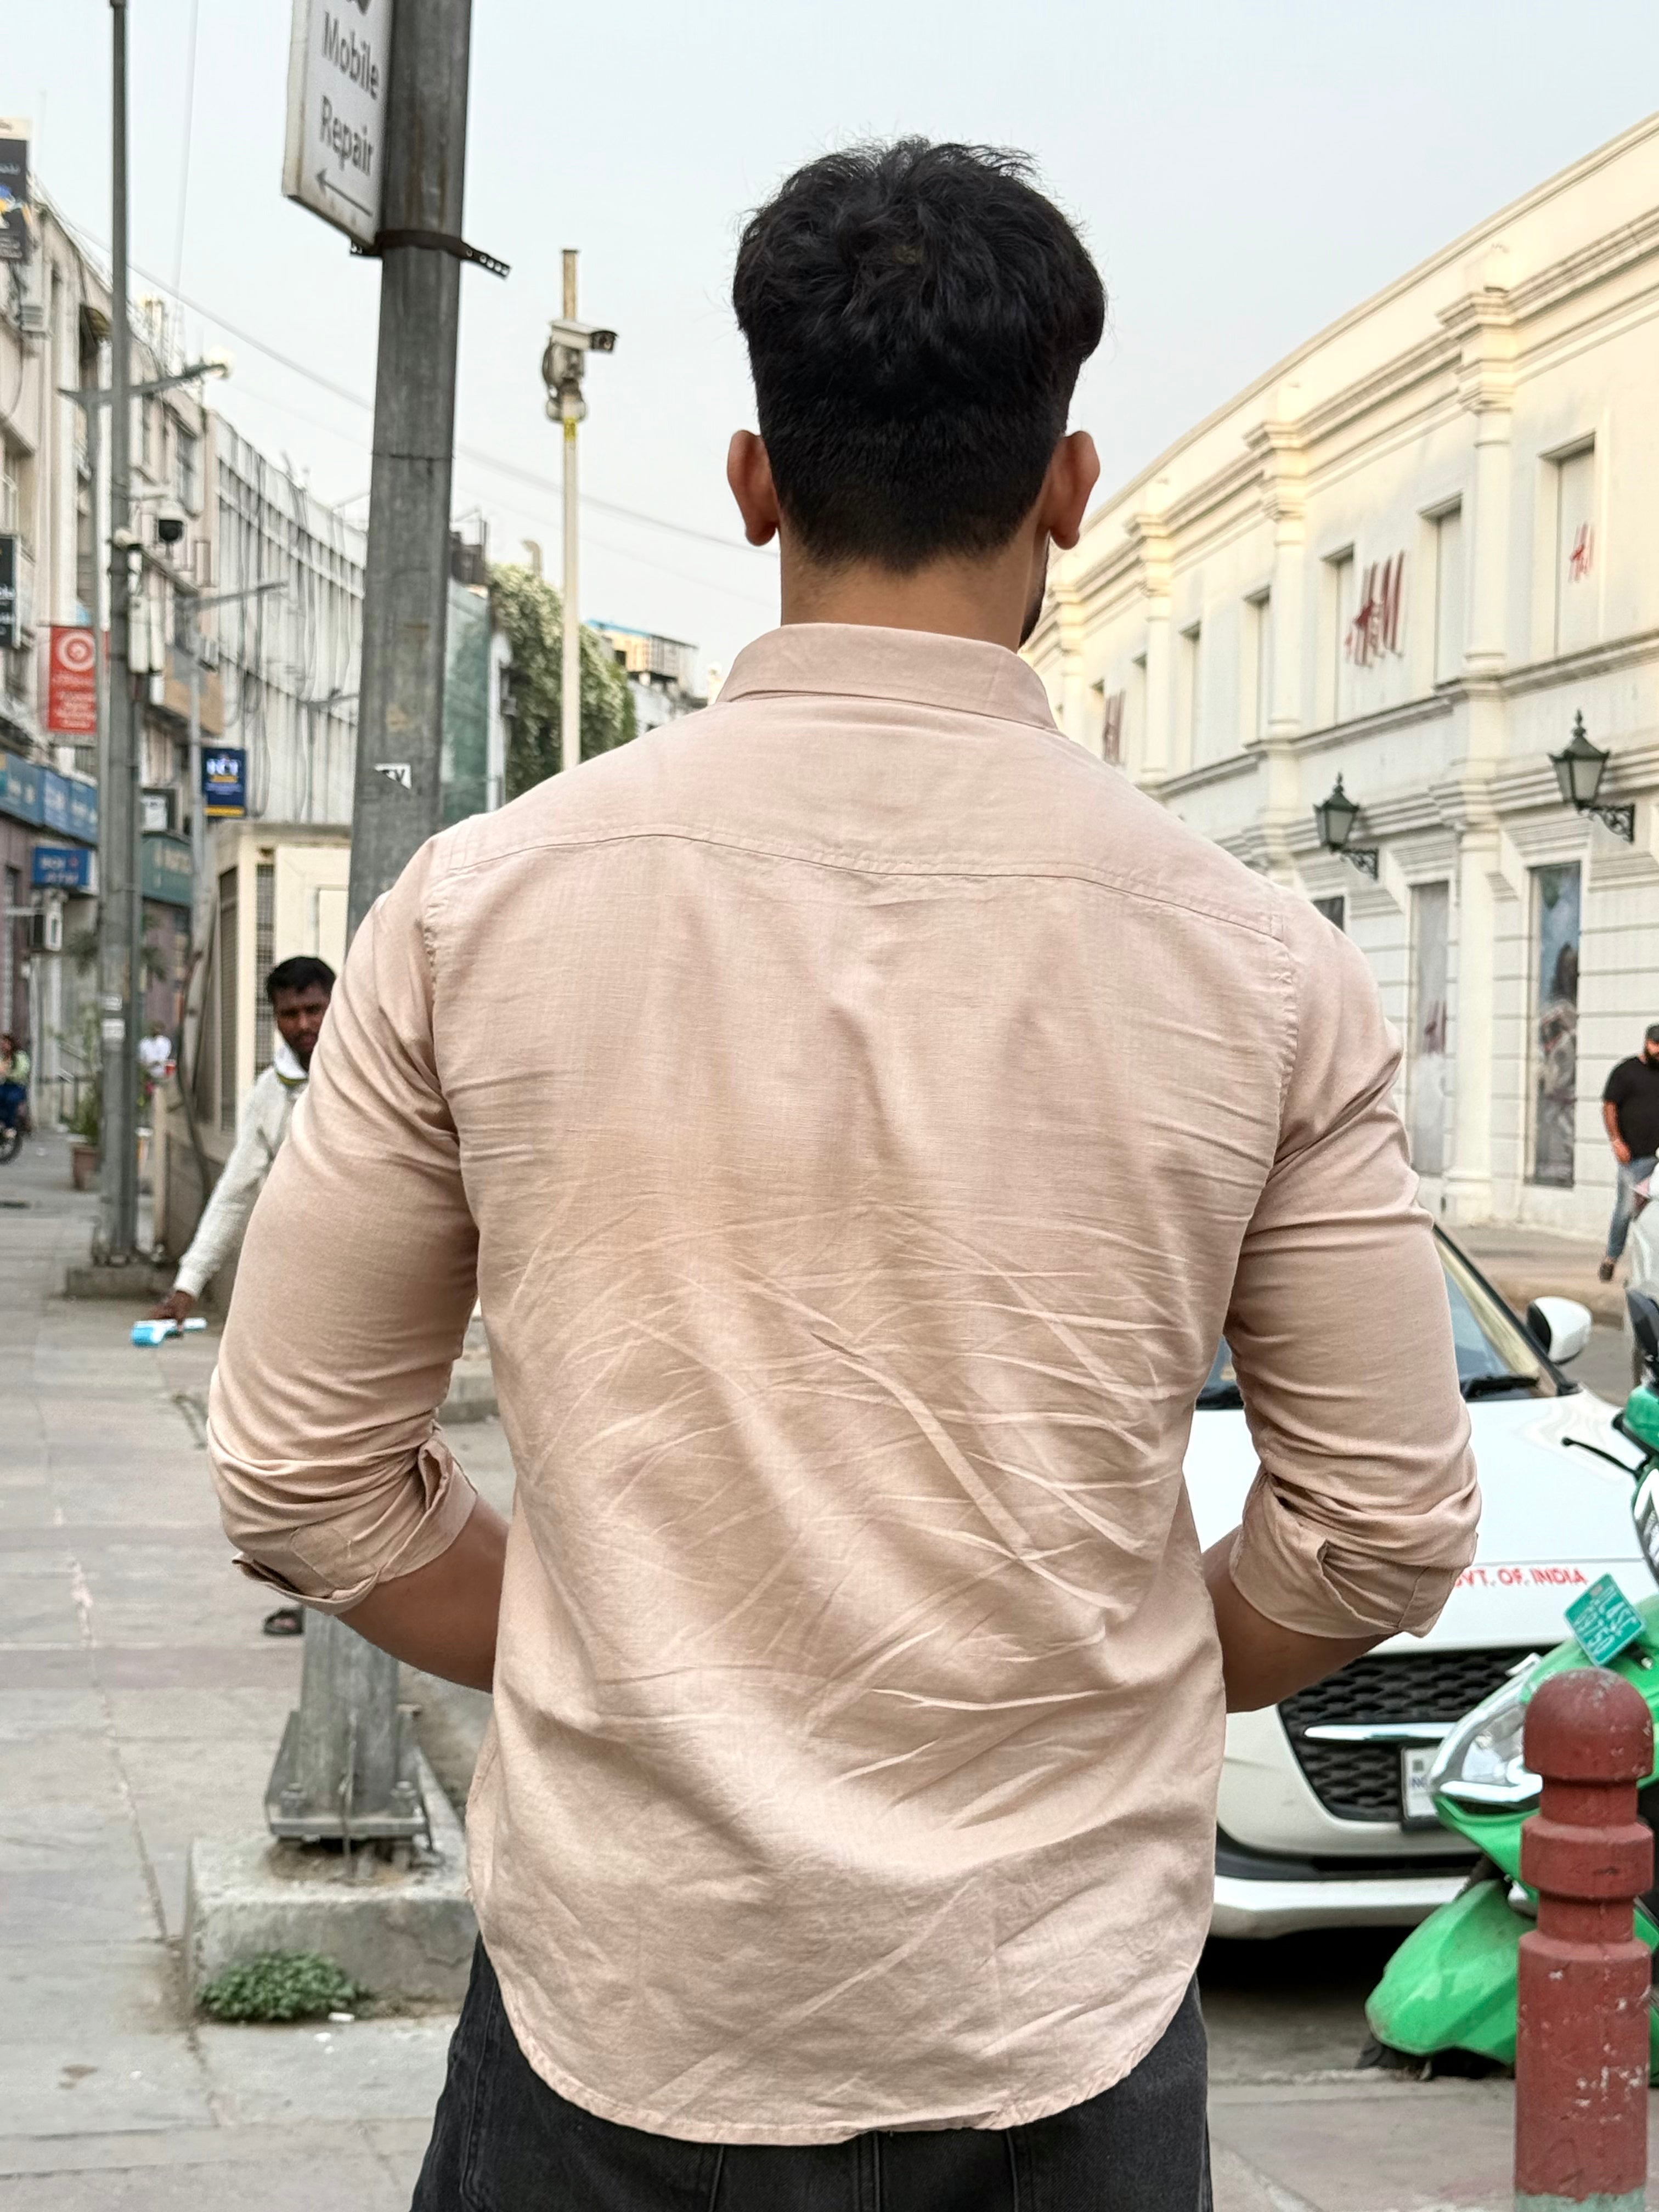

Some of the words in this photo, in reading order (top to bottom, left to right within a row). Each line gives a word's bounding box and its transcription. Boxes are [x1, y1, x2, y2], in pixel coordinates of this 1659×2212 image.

[323, 12, 379, 99] Mobile
[320, 96, 373, 176] Repair
[1531, 1567, 1587, 1585] INDIA
